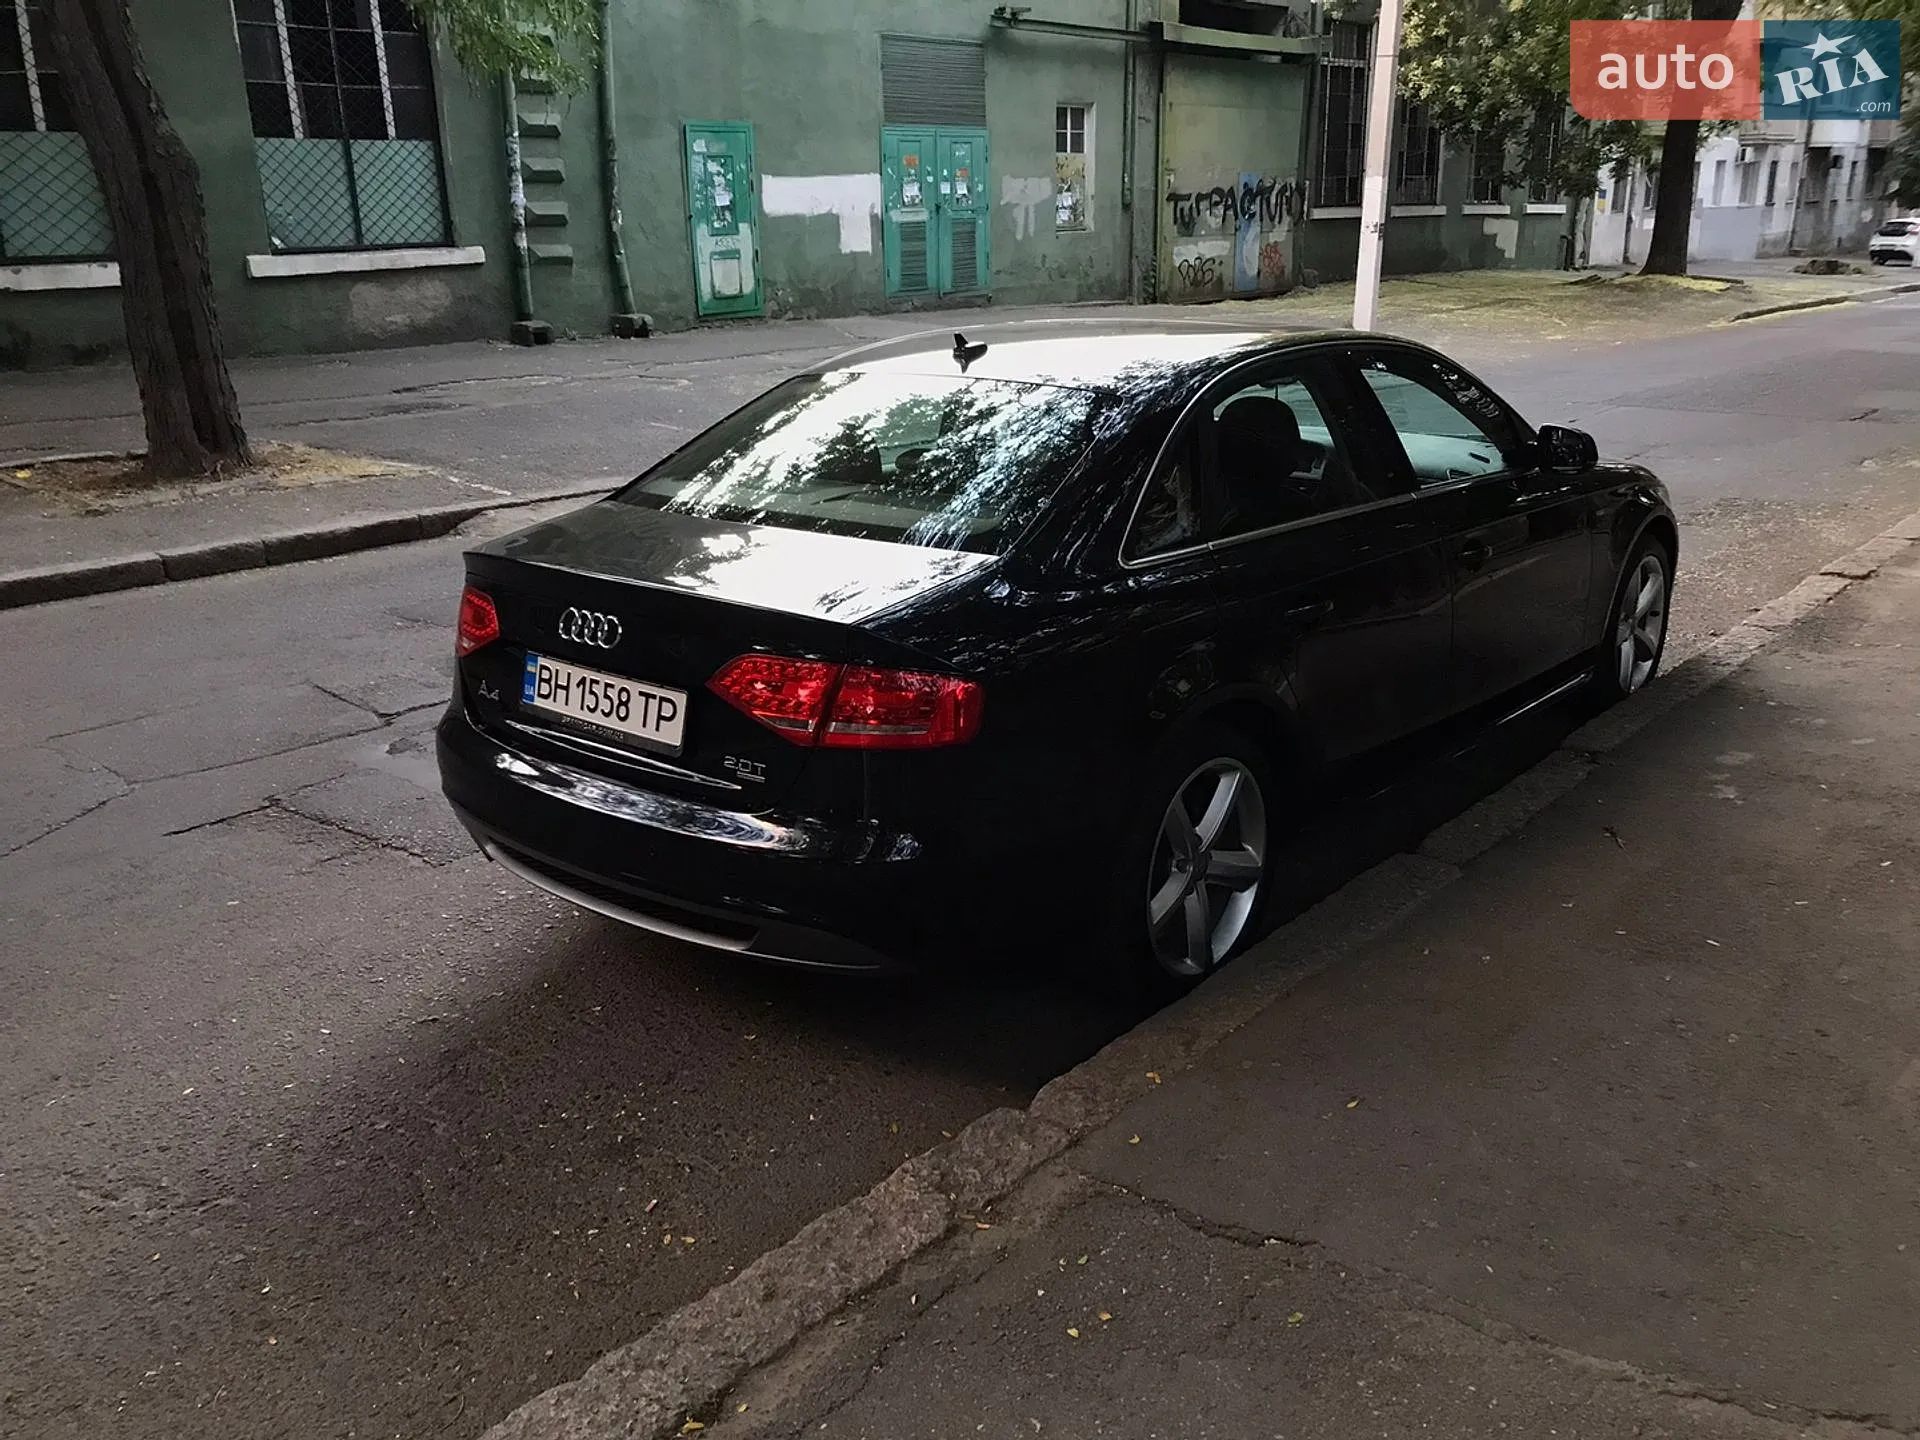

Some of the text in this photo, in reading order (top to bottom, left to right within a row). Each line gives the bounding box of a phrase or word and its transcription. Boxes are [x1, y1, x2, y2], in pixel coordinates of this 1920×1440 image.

[479, 679, 500, 701] A4
[537, 663, 572, 706] BH
[576, 675, 631, 722] 1558
[638, 690, 678, 732] TP
